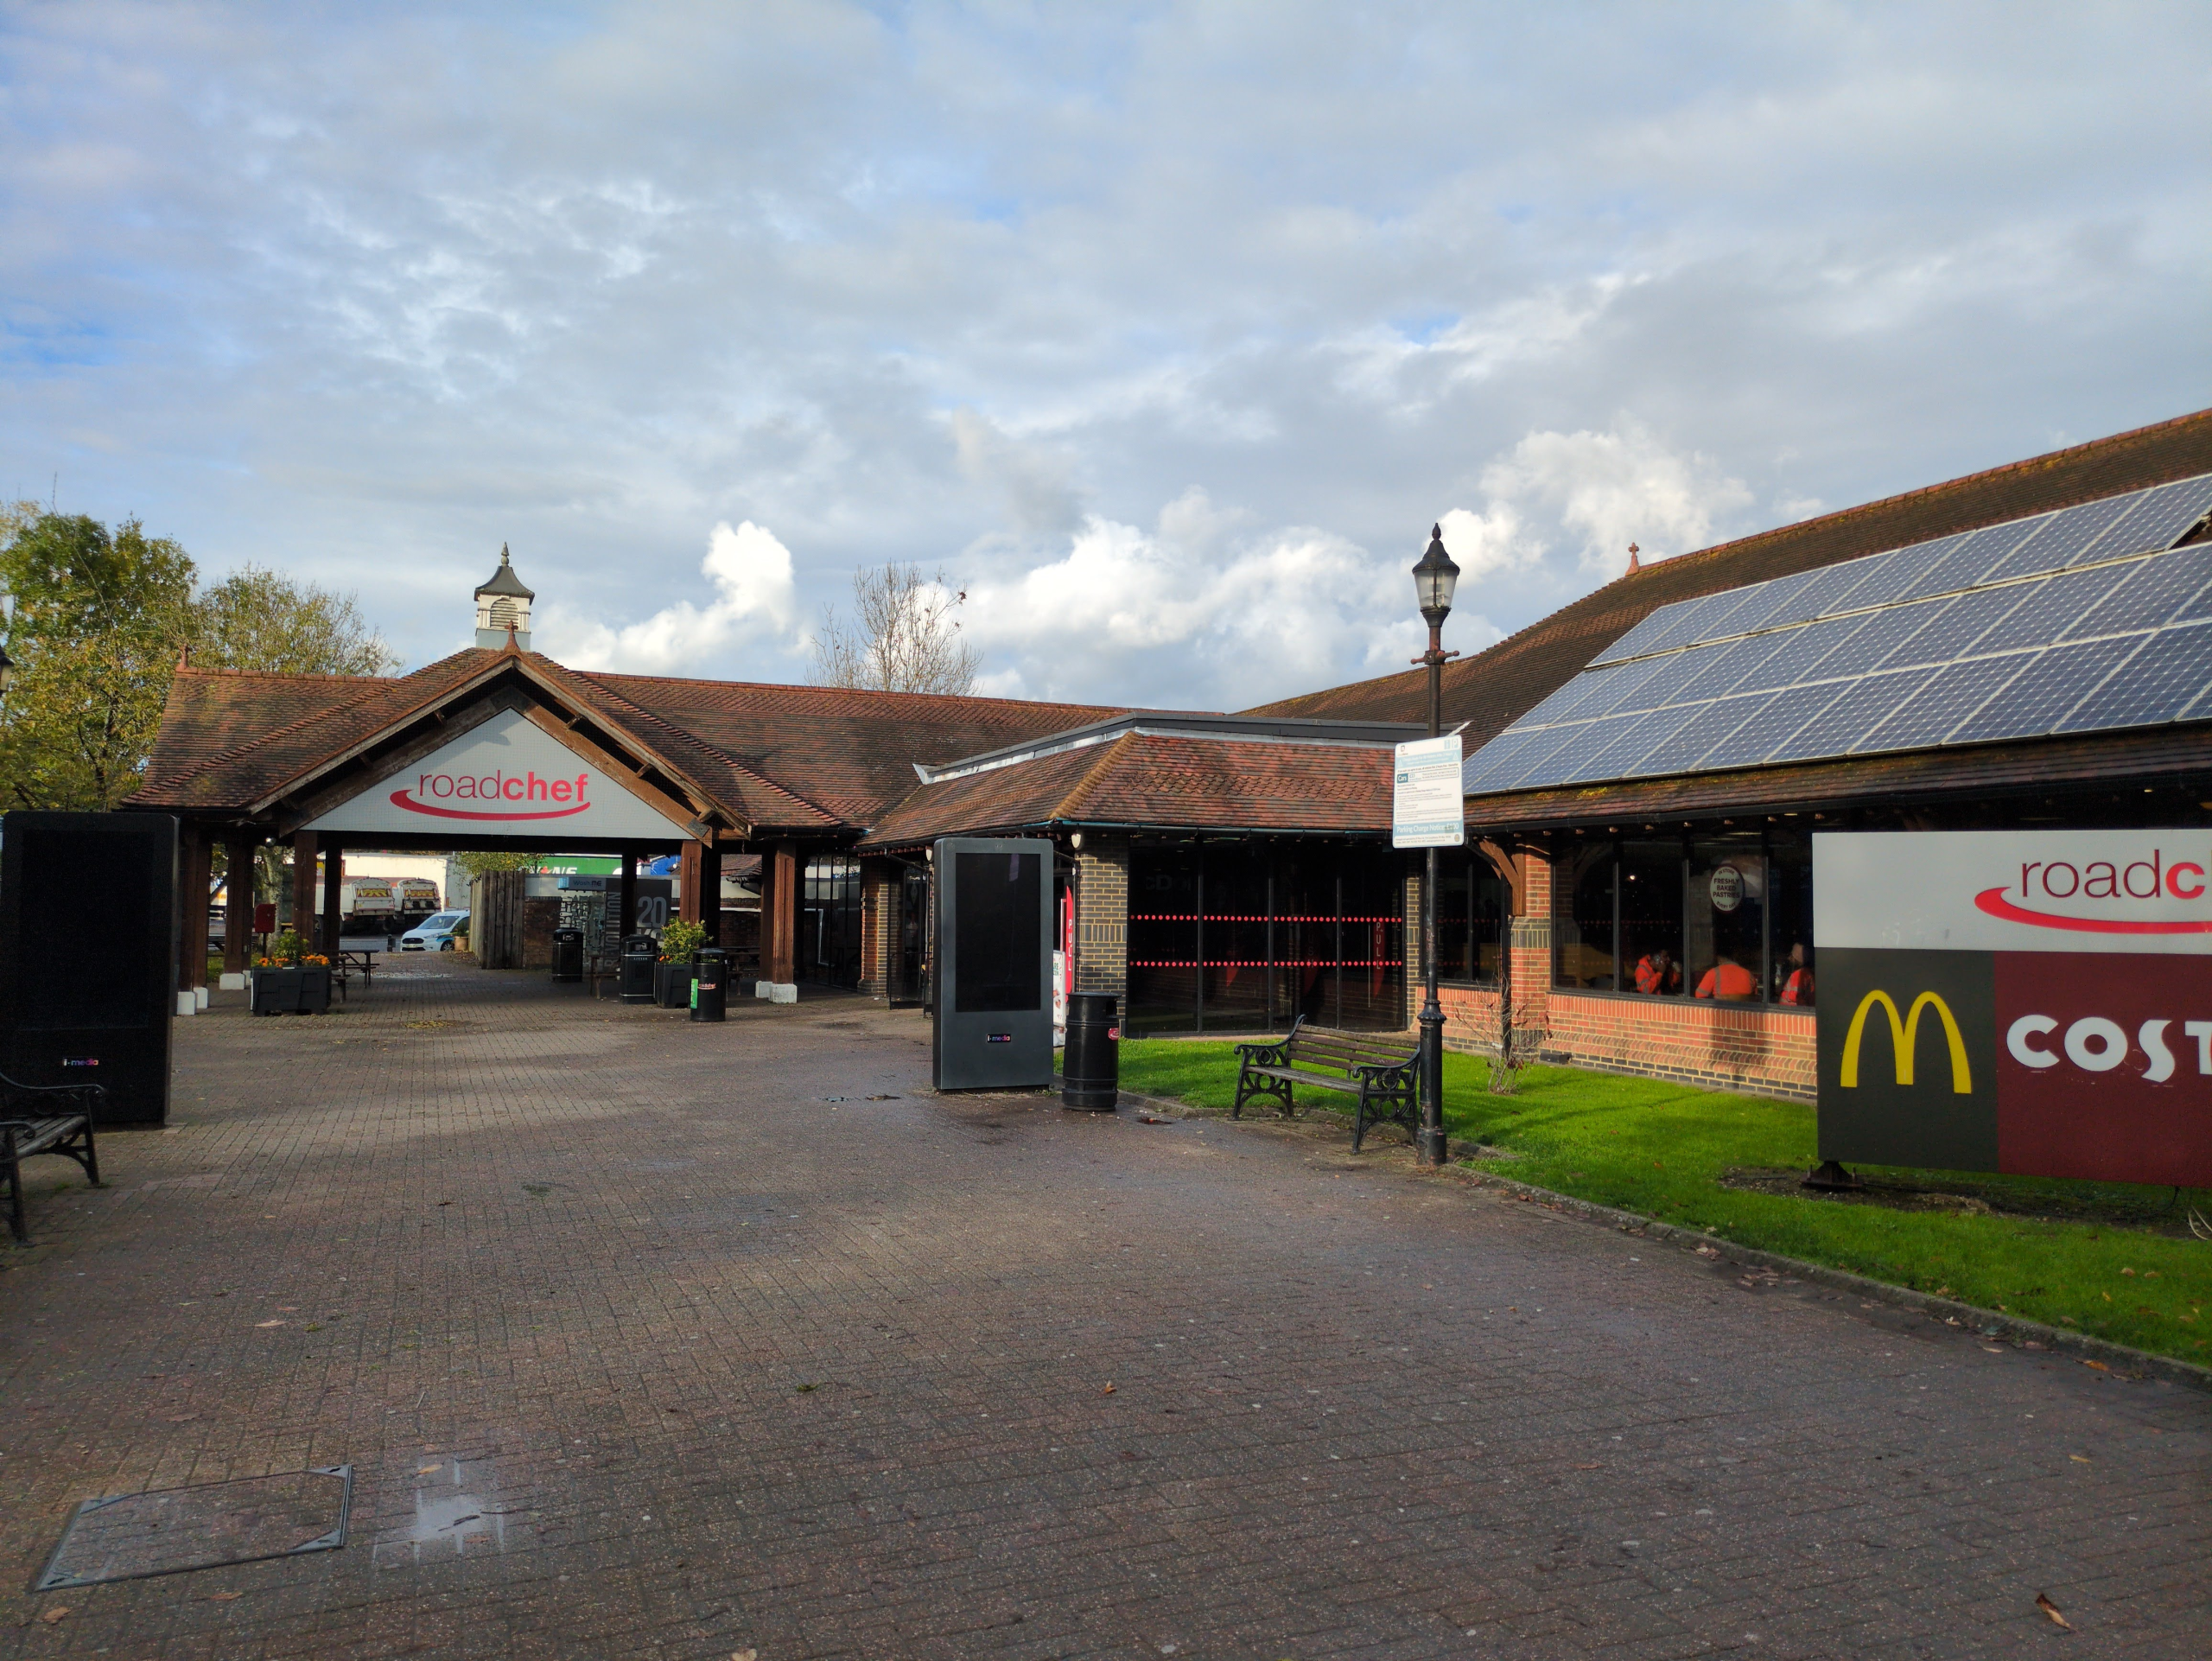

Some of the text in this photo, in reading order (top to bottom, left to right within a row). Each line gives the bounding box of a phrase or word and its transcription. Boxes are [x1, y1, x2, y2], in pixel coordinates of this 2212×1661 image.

[419, 769, 588, 802] roadchef
[1396, 825, 1413, 834] Parking
[1413, 824, 1429, 833] Charge
[2022, 849, 2212, 900] roadc
[637, 895, 667, 928] 20
[2006, 1014, 2212, 1083] COST
